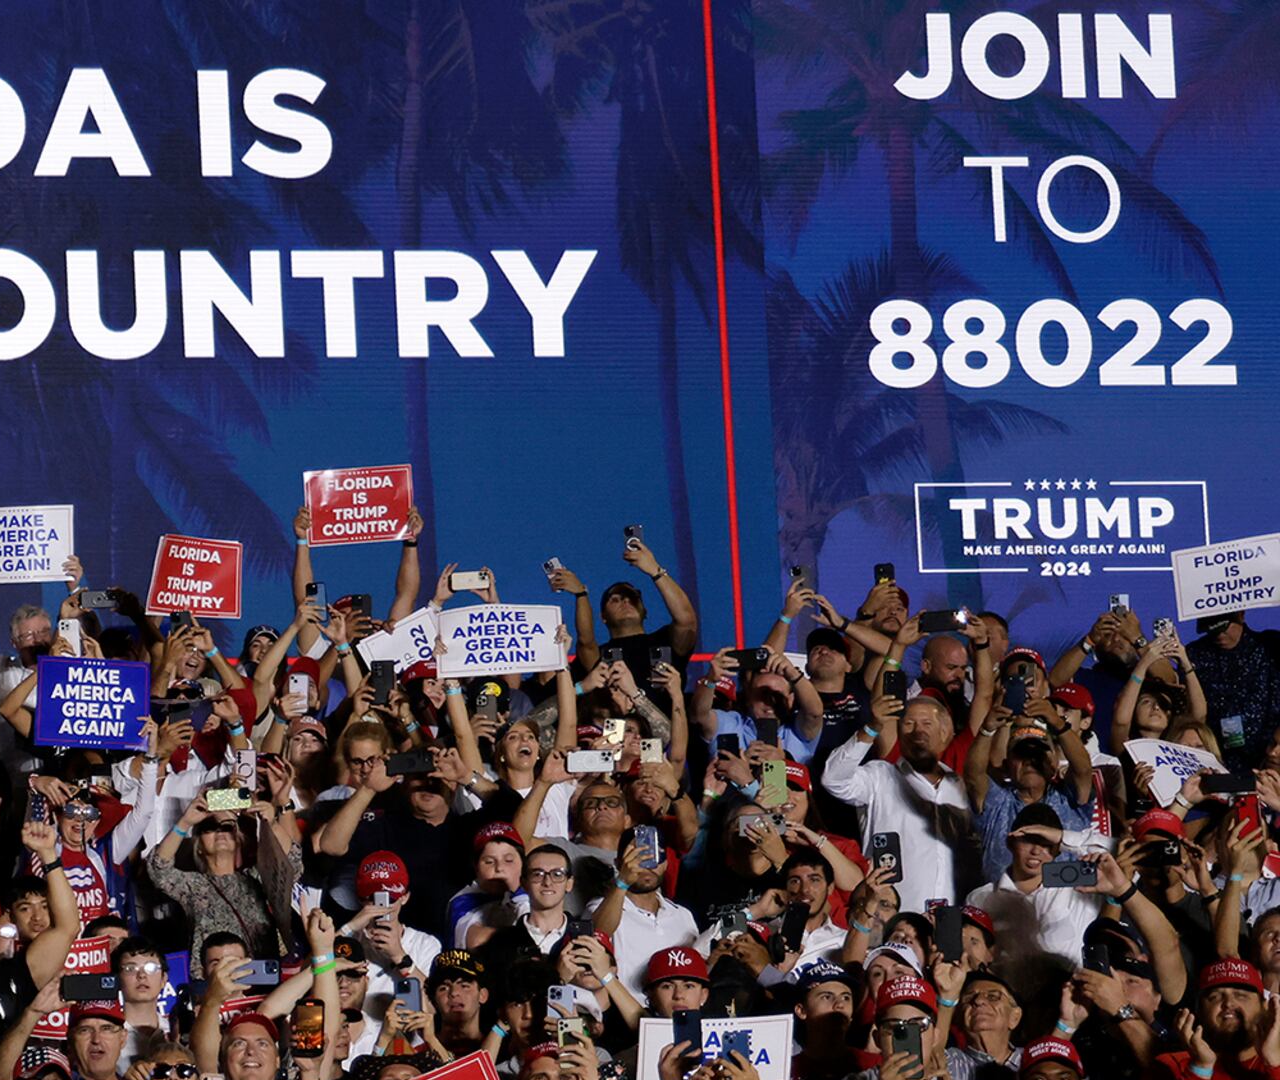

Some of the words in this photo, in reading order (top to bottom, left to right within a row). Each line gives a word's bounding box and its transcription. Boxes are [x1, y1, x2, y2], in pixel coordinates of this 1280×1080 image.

[893, 11, 1177, 100] JOIN
[198, 66, 335, 180] IS
[963, 155, 1122, 244] TO
[868, 298, 1238, 389] 88022
[326, 475, 394, 491] FLORIDA
[352, 492, 368, 505] IS
[332, 506, 388, 521] TRUMP
[948, 496, 1175, 541] TRUMP
[322, 519, 399, 536] COUNTRY
[168, 544, 221, 564] FLORIDA
[963, 544, 1002, 556] MAKE
[1005, 544, 1067, 556] AMERICA
[1070, 543, 1115, 556] GREAT
[1117, 543, 1166, 556] AGAIN!
[1193, 545, 1266, 570] FLORIDA
[182, 562, 195, 576] IS
[1040, 561, 1092, 577] 2024
[1224, 565, 1240, 578] IS
[167, 576, 213, 594] TRUMP
[1205, 575, 1264, 596] TRUMP
[156, 591, 224, 610] COUNTRY
[1194, 586, 1276, 611] COUNTRY
[469, 610, 527, 624] MAKE
[452, 623, 545, 640] AMERICA
[410, 624, 432, 659] 022
[465, 637, 534, 651] GREAT
[464, 651, 536, 665] AGAIN!
[68, 666, 120, 685] MAKE
[50, 683, 136, 704] AMERICA
[61, 702, 125, 720] GREAT
[58, 719, 126, 738] AGAIN!
[64, 947, 109, 970] ORIDA
